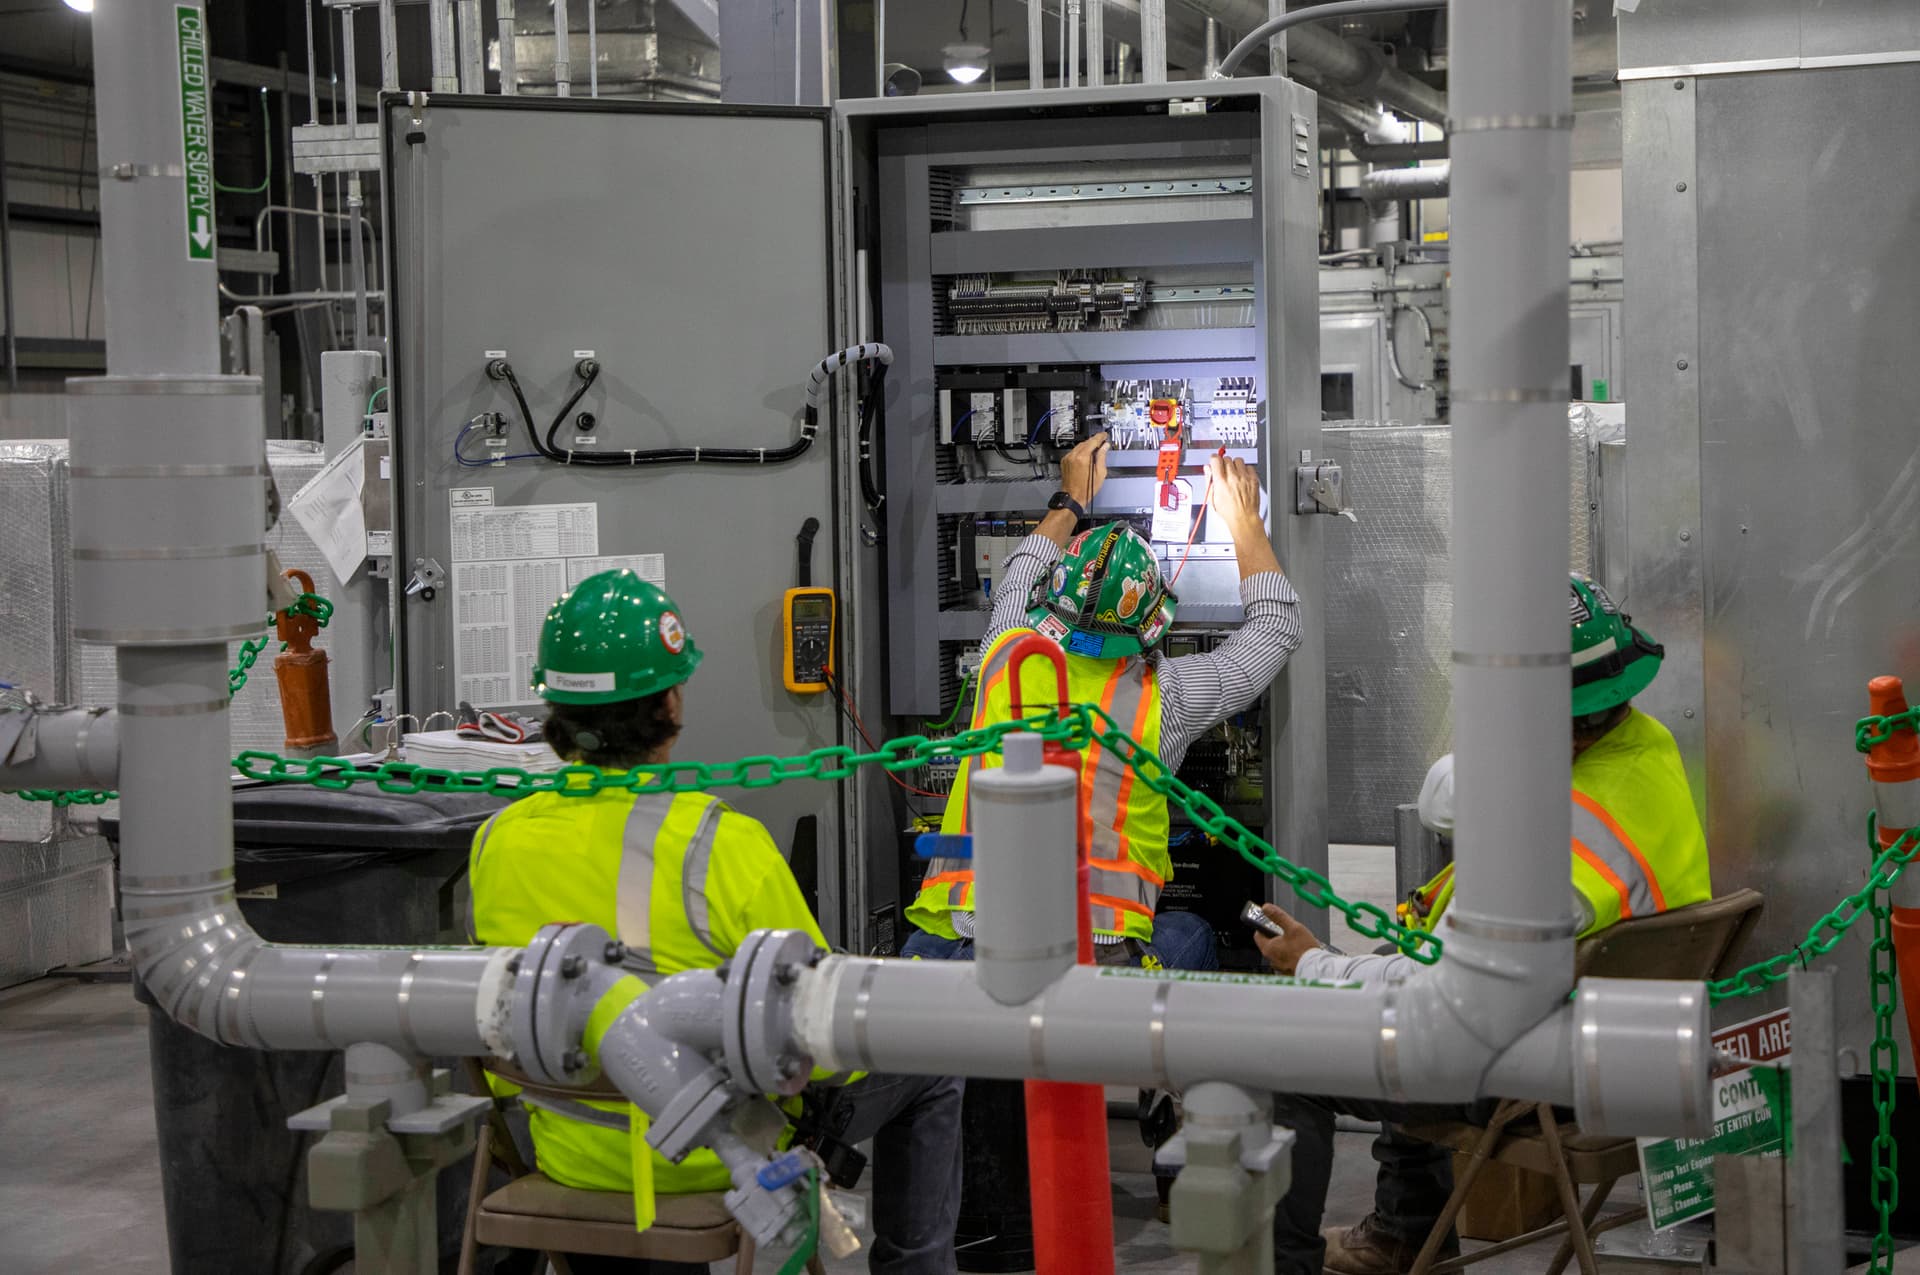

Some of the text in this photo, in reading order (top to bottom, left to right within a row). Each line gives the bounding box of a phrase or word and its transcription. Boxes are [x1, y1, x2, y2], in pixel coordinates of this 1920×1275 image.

[181, 17, 210, 215] CHILLED WATER SUPPLY
[556, 676, 596, 688] Flowers
[1714, 1019, 1791, 1061] TED ARE
[1727, 1113, 1753, 1134] ENTRY
[1755, 1107, 1772, 1123] CON
[1675, 1163, 1689, 1175] Test
